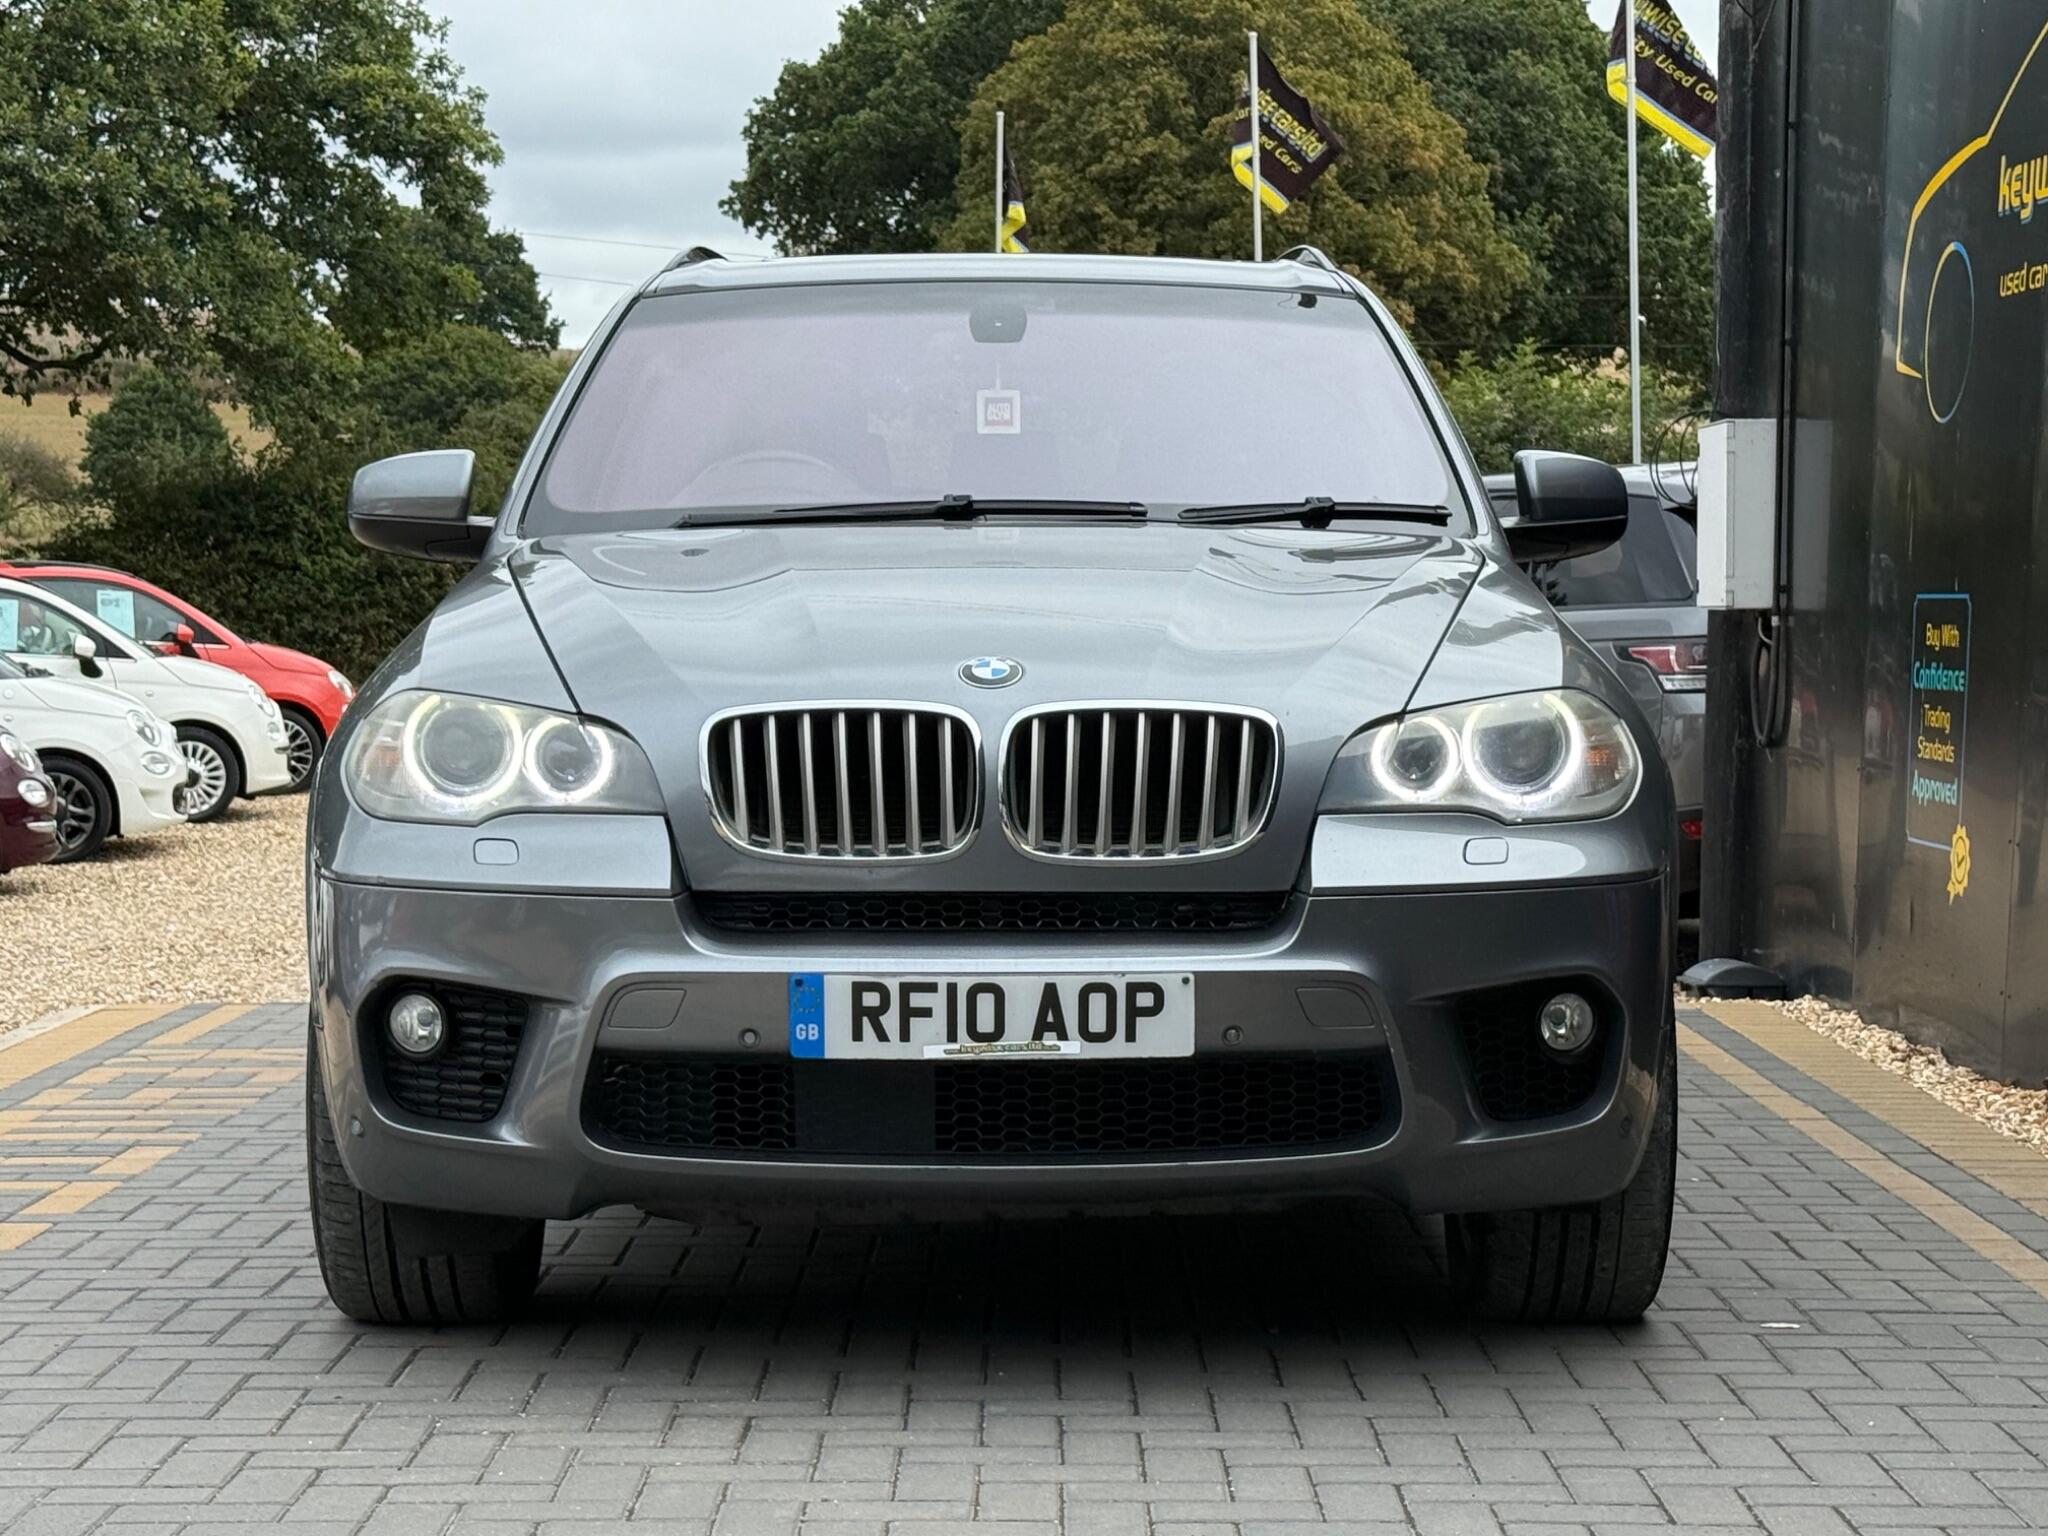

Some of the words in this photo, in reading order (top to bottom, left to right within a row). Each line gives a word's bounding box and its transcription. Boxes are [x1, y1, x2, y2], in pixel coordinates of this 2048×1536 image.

[1655, 54, 1697, 88] Used
[1275, 147, 1303, 174] Cars
[2000, 261, 2027, 297] used
[1925, 622, 1941, 651] Buy
[1941, 624, 1960, 648] With
[1913, 661, 1965, 692] Confidence
[1923, 704, 1951, 734] Trading
[1917, 736, 1955, 763] Standards
[1912, 769, 1957, 806] Approved
[851, 980, 1006, 1044] RF10
[1031, 980, 1165, 1044] AOP
[796, 1024, 819, 1040] GB
